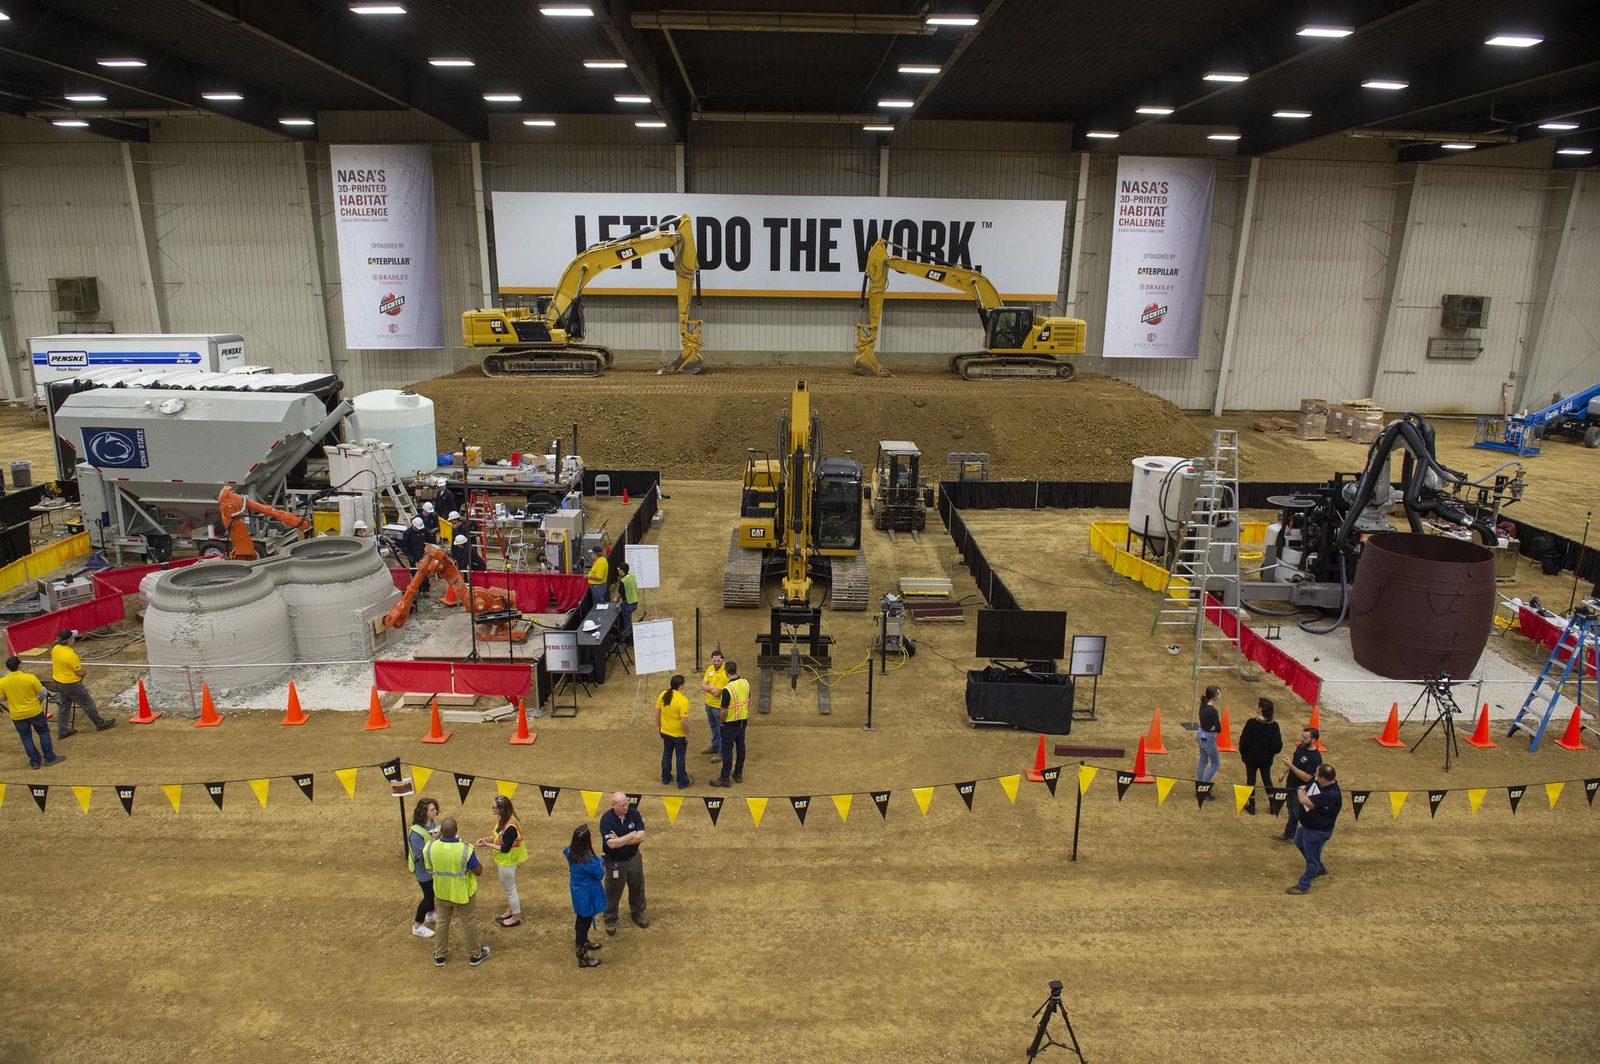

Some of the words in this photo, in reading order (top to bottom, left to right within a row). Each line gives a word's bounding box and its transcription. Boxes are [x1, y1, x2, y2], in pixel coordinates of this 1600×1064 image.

[337, 169, 386, 183] NASA'S
[337, 184, 387, 193] 3D-PRINTED
[1121, 180, 1169, 194] NASA'S
[339, 194, 388, 206] HABITAT
[1120, 195, 1168, 204] 3D-PRINTED
[340, 207, 389, 217] CHALLENGE
[1119, 205, 1166, 217] HABITAT
[1118, 218, 1166, 228] CHALLENGE
[696, 216, 752, 271] DO
[763, 217, 842, 273] THE
[621, 248, 634, 259] CAT
[367, 257, 410, 266] CATERPILLAR
[928, 270, 941, 280] CAT
[1137, 267, 1179, 276] CATERPILLAR
[1142, 307, 1167, 322] BECHTEL
[491, 320, 501, 328] CAT
[221, 347, 242, 356] PENSKE
[136, 429, 145, 449] STATE
[139, 449, 148, 467] PENN
[751, 528, 765, 537] CAT
[383, 766, 396, 776] CAT
[1045, 771, 1058, 780] CAT
[298, 777, 312, 787] CAT
[458, 778, 471, 787] CAT
[1118, 776, 1132, 785] CAT
[210, 786, 222, 795] CAT
[960, 785, 973, 794] CAT
[1587, 782, 1599, 790] CAT
[33, 789, 45, 797] CAT
[120, 790, 133, 799] CAT
[544, 790, 557, 799] CAT
[1275, 792, 1288, 800] CAT
[1510, 790, 1523, 798] CAT
[875, 794, 888, 803] CAT
[1353, 795, 1366, 803] CAT
[1431, 794, 1443, 802] CAT
[708, 800, 721, 809] CAT
[795, 800, 807, 809] CAT
